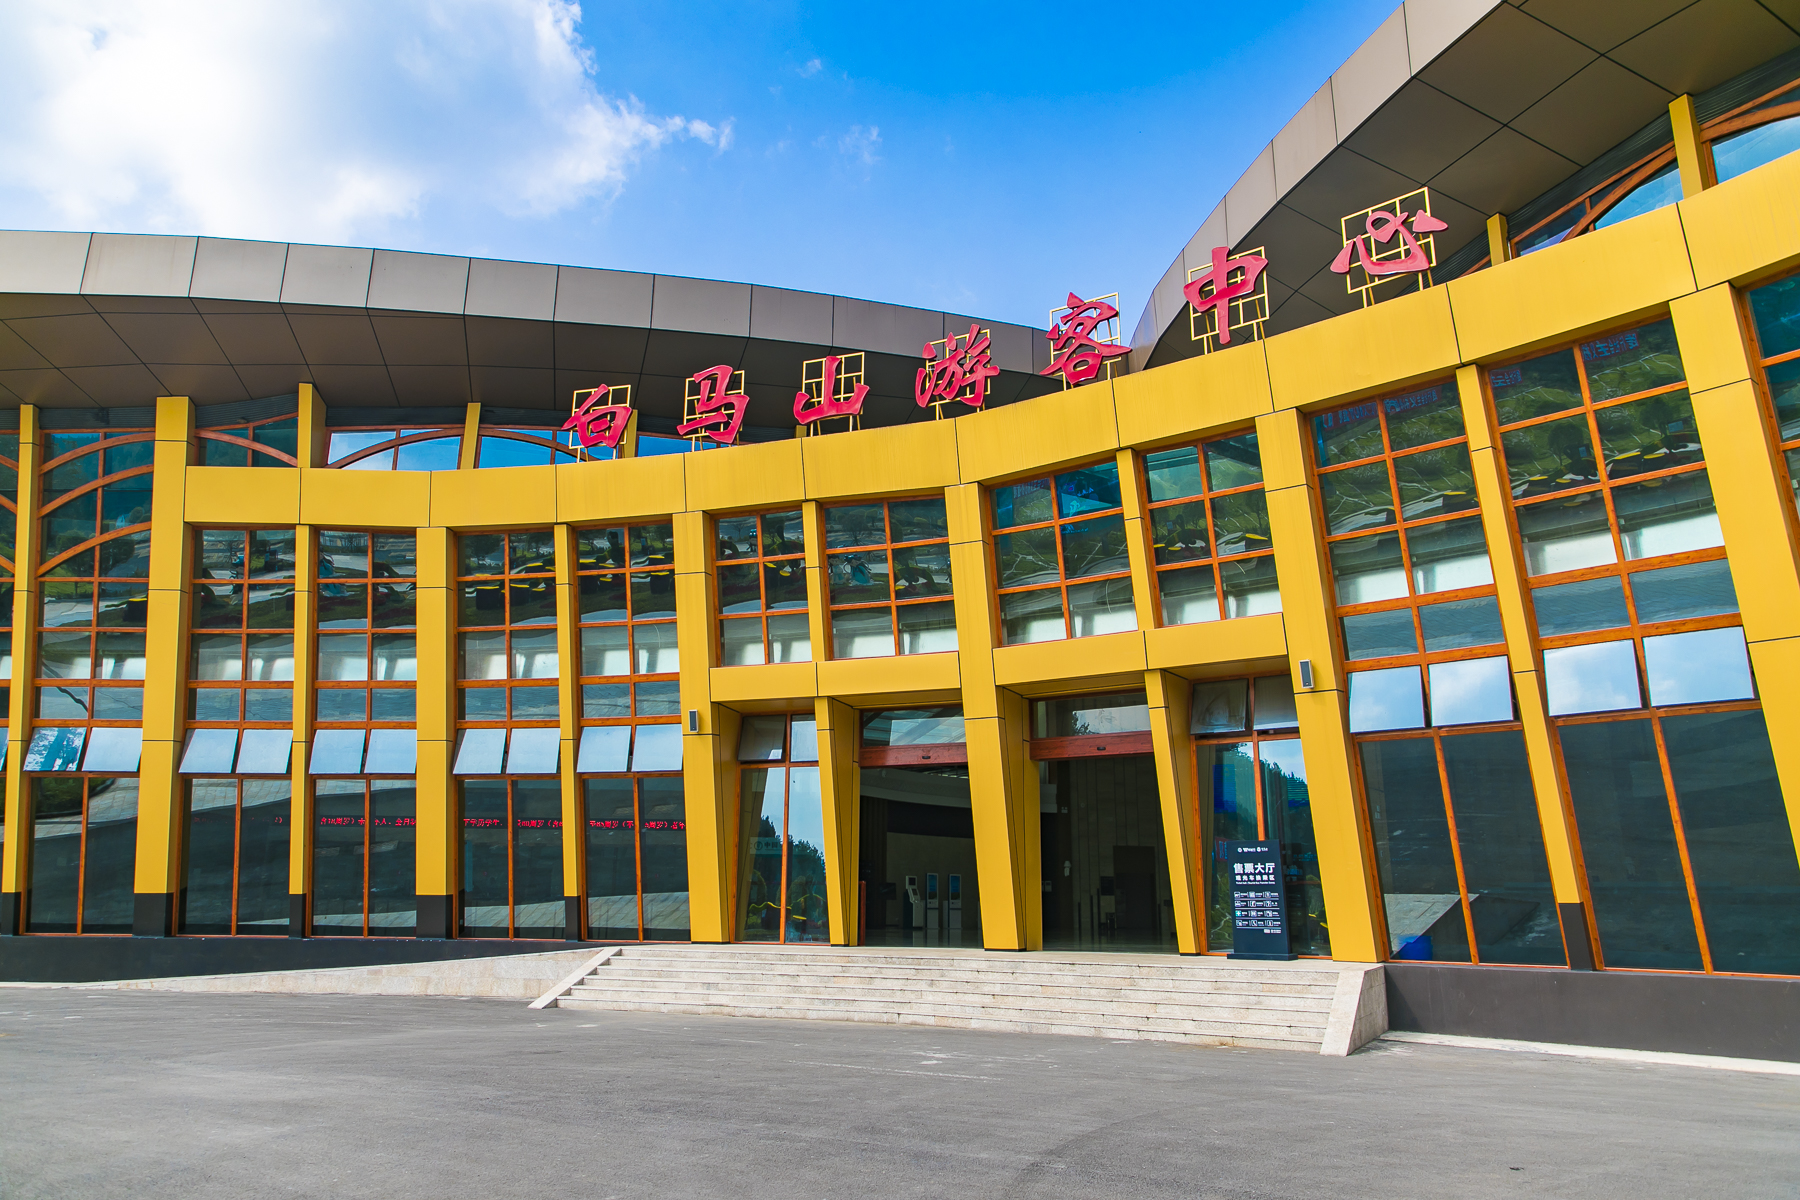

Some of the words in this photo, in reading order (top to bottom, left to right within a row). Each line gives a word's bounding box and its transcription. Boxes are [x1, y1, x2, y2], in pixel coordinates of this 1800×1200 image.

[562, 210, 1449, 449] 白马山游客中心
[1233, 862, 1275, 873] 售票大厅
